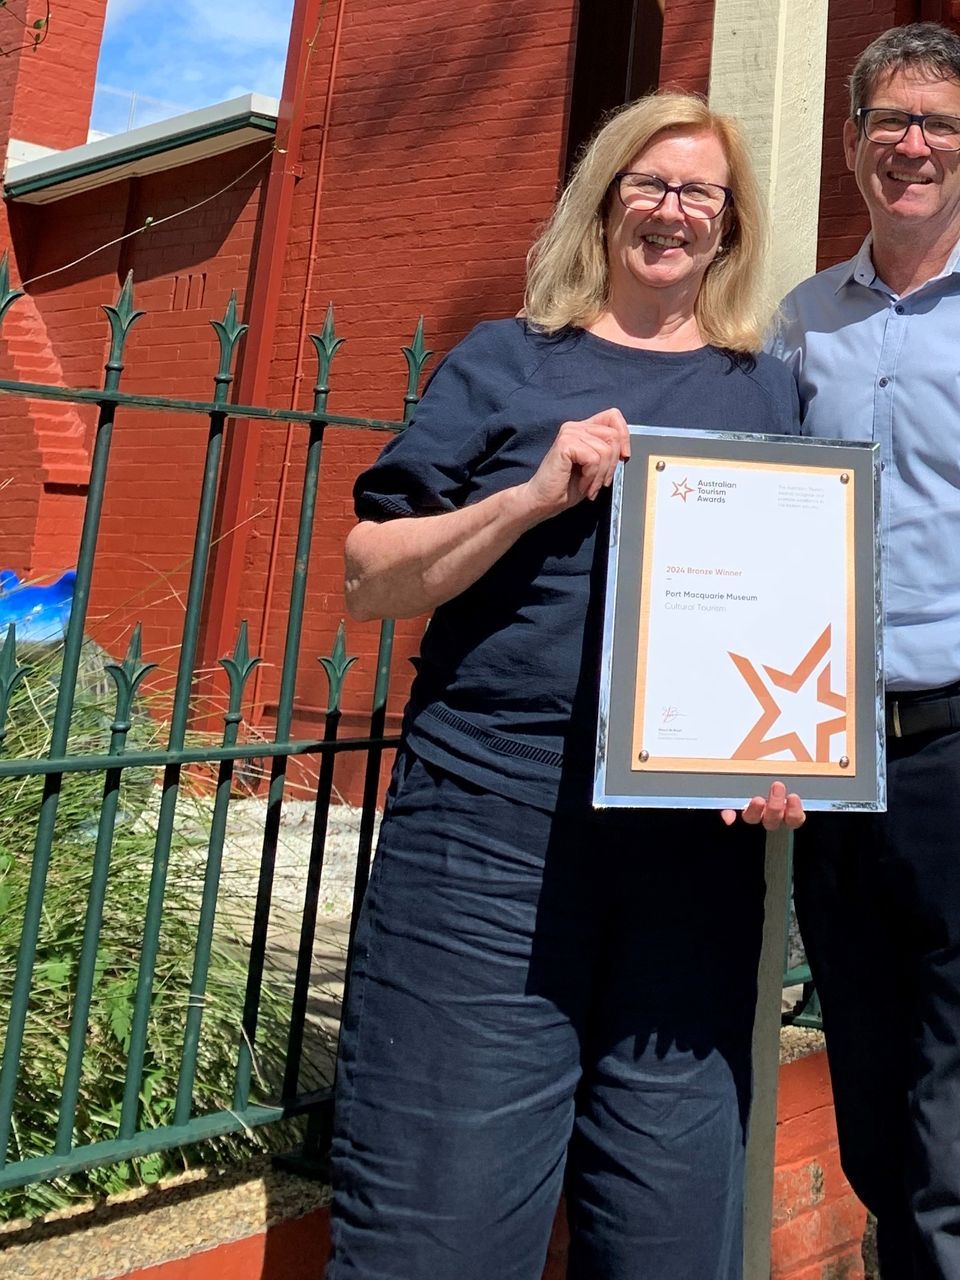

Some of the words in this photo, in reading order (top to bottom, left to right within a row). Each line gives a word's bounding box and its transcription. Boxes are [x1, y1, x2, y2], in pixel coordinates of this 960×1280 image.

[697, 480, 737, 489] Australian
[697, 487, 727, 495] Tourism
[697, 495, 726, 504] Awards
[666, 566, 685, 574] 2024
[687, 567, 713, 575] Bronze
[715, 569, 742, 577] Winner
[665, 590, 682, 598] Port
[683, 591, 725, 601] Macquarie
[726, 593, 758, 601] Museum
[664, 602, 695, 611] Cultural
[697, 604, 727, 612] Tourism
